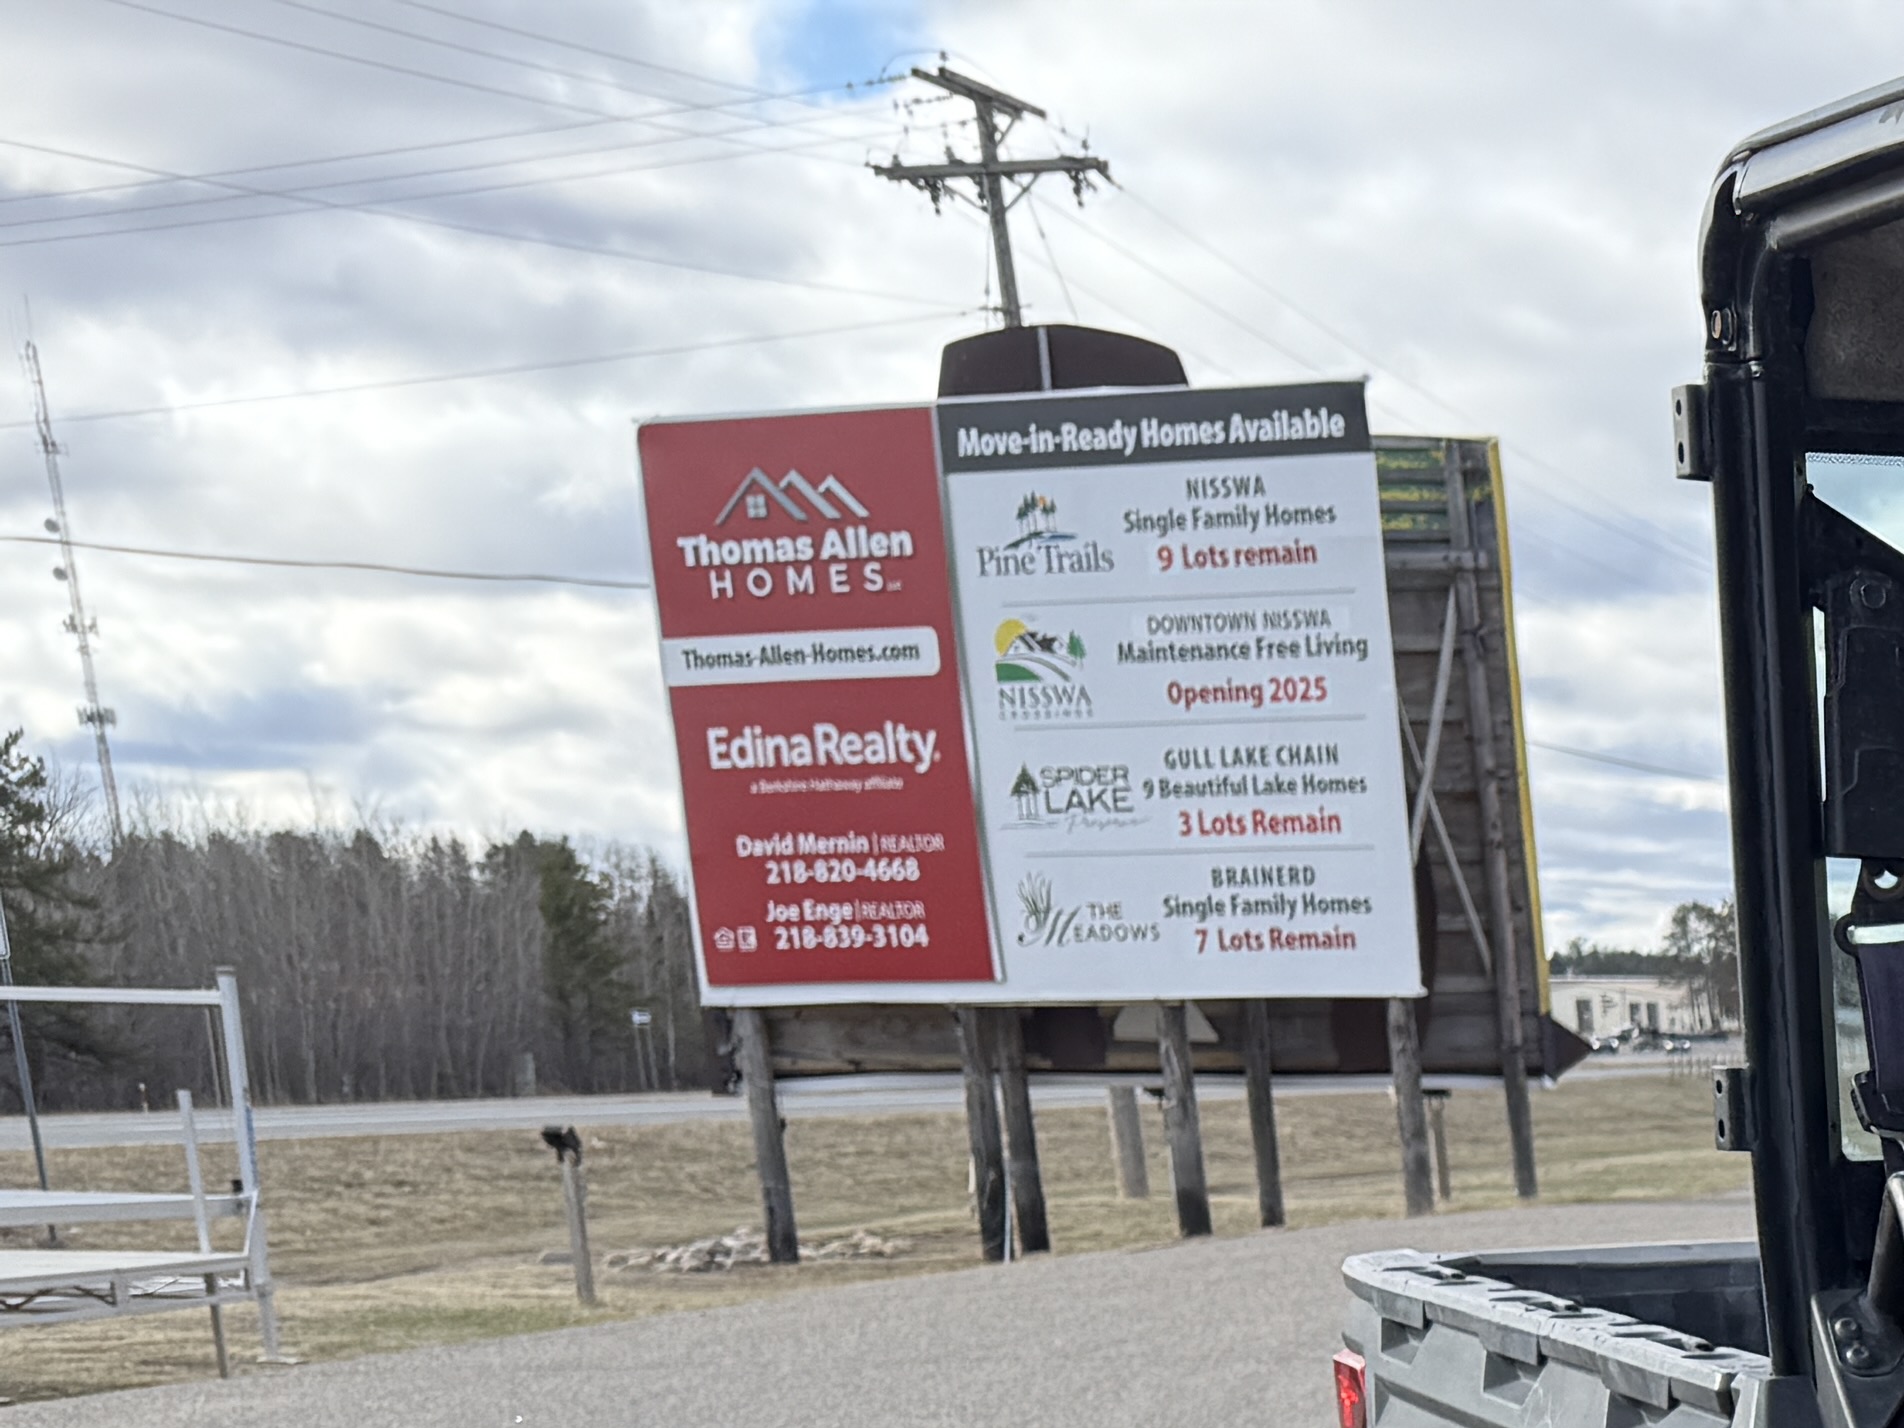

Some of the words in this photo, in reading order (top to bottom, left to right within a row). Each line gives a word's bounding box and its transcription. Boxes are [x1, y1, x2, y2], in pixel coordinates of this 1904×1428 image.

[958, 419, 1137, 457] Move-in-Ready
[1141, 417, 1226, 448] Homes
[1229, 407, 1346, 445] Available
[1186, 473, 1266, 501] NISSWA
[1124, 507, 1188, 538] Single
[1192, 504, 1260, 533] Family
[1265, 502, 1337, 526] Homes
[676, 533, 814, 567] Thomas
[819, 524, 914, 560] Allen
[976, 545, 1036, 578] Pine
[1036, 541, 1115, 574] Trails
[1157, 545, 1174, 571] 9
[1182, 543, 1230, 571] Lots
[1234, 539, 1318, 567] remain
[709, 561, 884, 599] HOMES
[1146, 610, 1257, 636] DOWNTOWN
[1262, 608, 1332, 631] NISSWA
[1117, 637, 1251, 665] Maintenance
[1256, 636, 1300, 660] Free
[1305, 632, 1369, 663] Living
[998, 683, 1093, 710] NISSWA
[1166, 677, 1264, 711] Opening
[1268, 676, 1329, 704] 2025
[1164, 747, 1215, 770] GULL
[1220, 745, 1271, 769] LAKE
[1276, 743, 1340, 767] CHAIN
[1039, 764, 1130, 788] SPIDER
[1142, 777, 1154, 800] 9
[1158, 775, 1248, 799] Beautiful
[1252, 774, 1298, 797] Lake
[1302, 774, 1368, 795] Homes
[1044, 787, 1134, 814] LAKE
[1178, 810, 1192, 837] 3
[1198, 809, 1246, 837] Lots
[1252, 805, 1342, 835] Remain
[736, 832, 794, 858] David
[1210, 864, 1316, 890] BRAINERD
[766, 900, 801, 923] Joe
[803, 898, 854, 925] Enge
[1086, 900, 1122, 921] THE
[1162, 895, 1227, 923] Single
[1231, 893, 1298, 921] Family
[1302, 891, 1373, 916] Homes
[1194, 928, 1208, 953] 7
[1218, 927, 1265, 952] Lots
[1270, 924, 1357, 951] Remain
